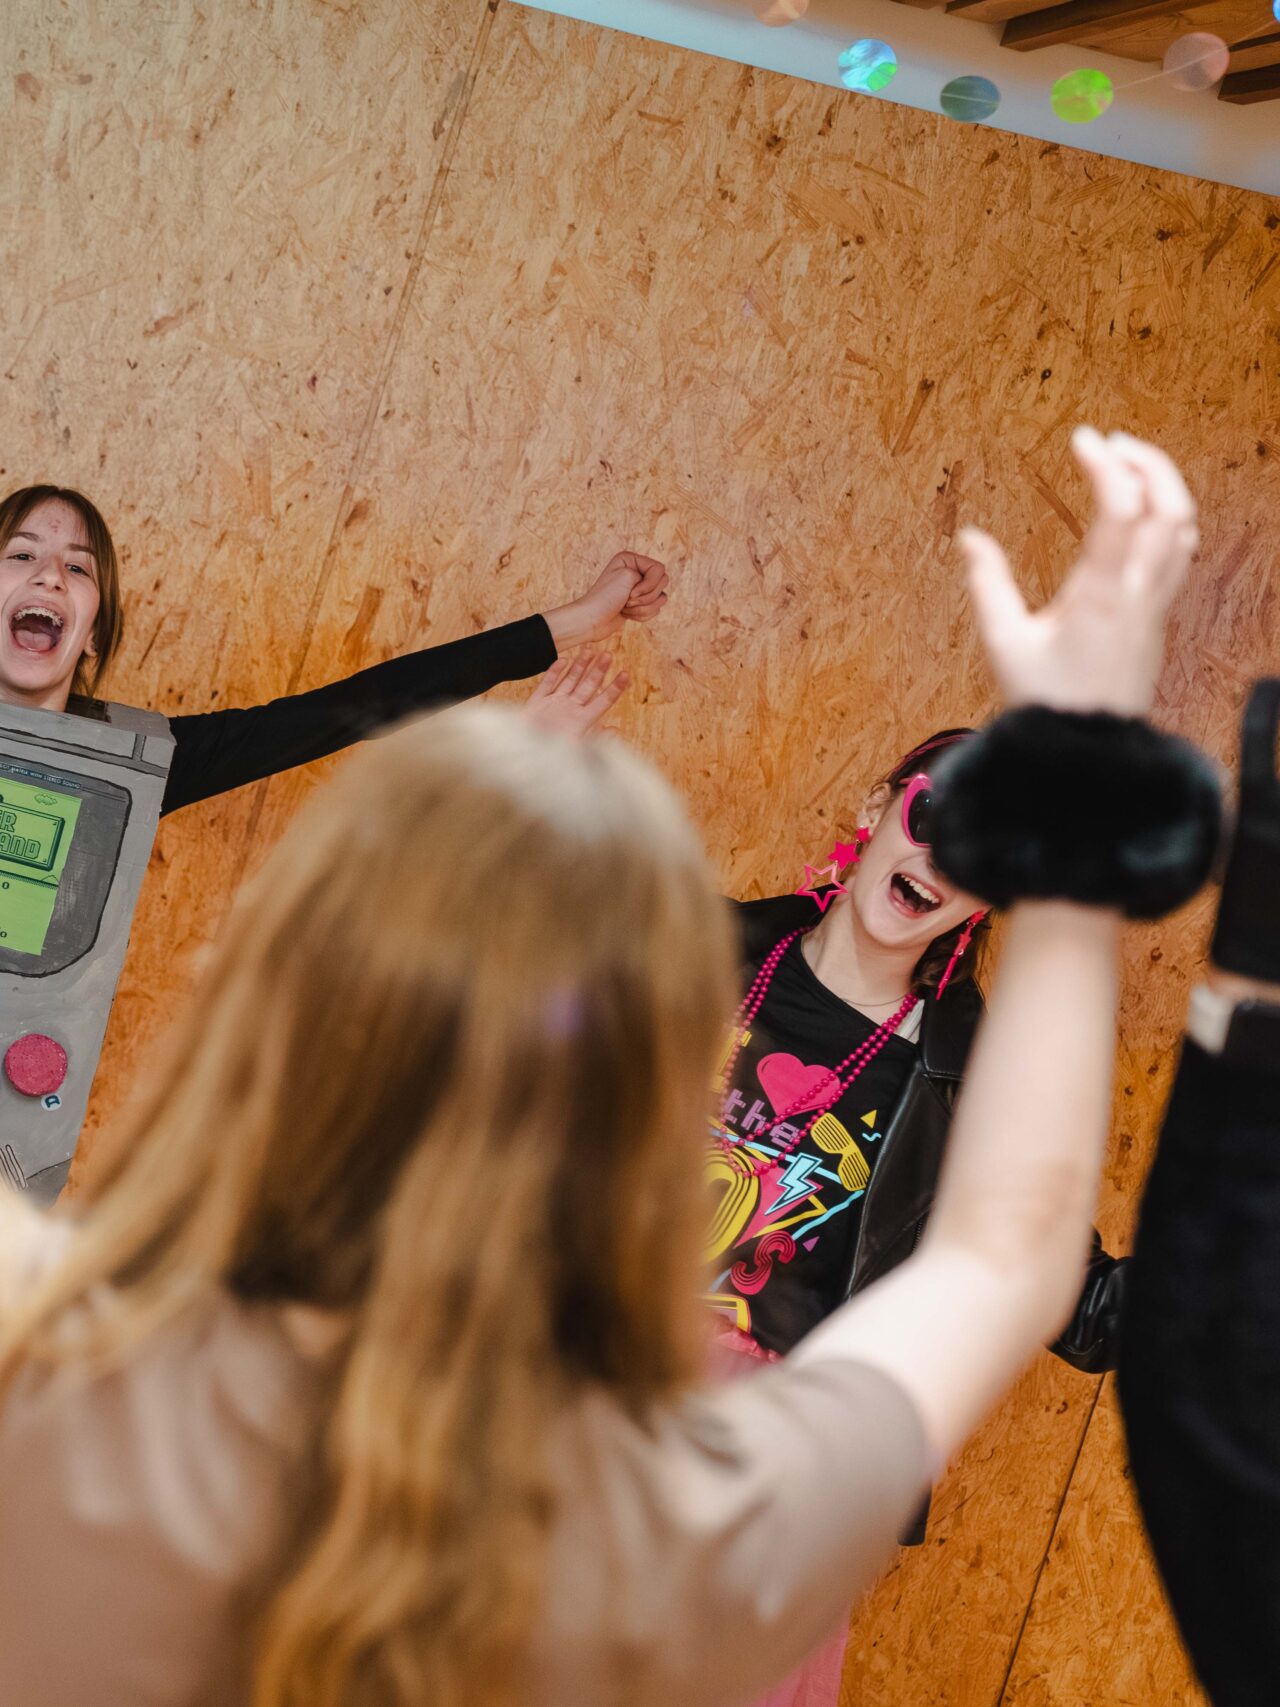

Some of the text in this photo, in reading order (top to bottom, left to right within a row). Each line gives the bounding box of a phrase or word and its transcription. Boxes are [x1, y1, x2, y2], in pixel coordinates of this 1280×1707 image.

[44, 775, 61, 784] STEREO
[63, 781, 80, 789] SOUND
[1, 882, 10, 890] 0
[44, 1095, 60, 1108] A
[721, 1088, 800, 1149] the
